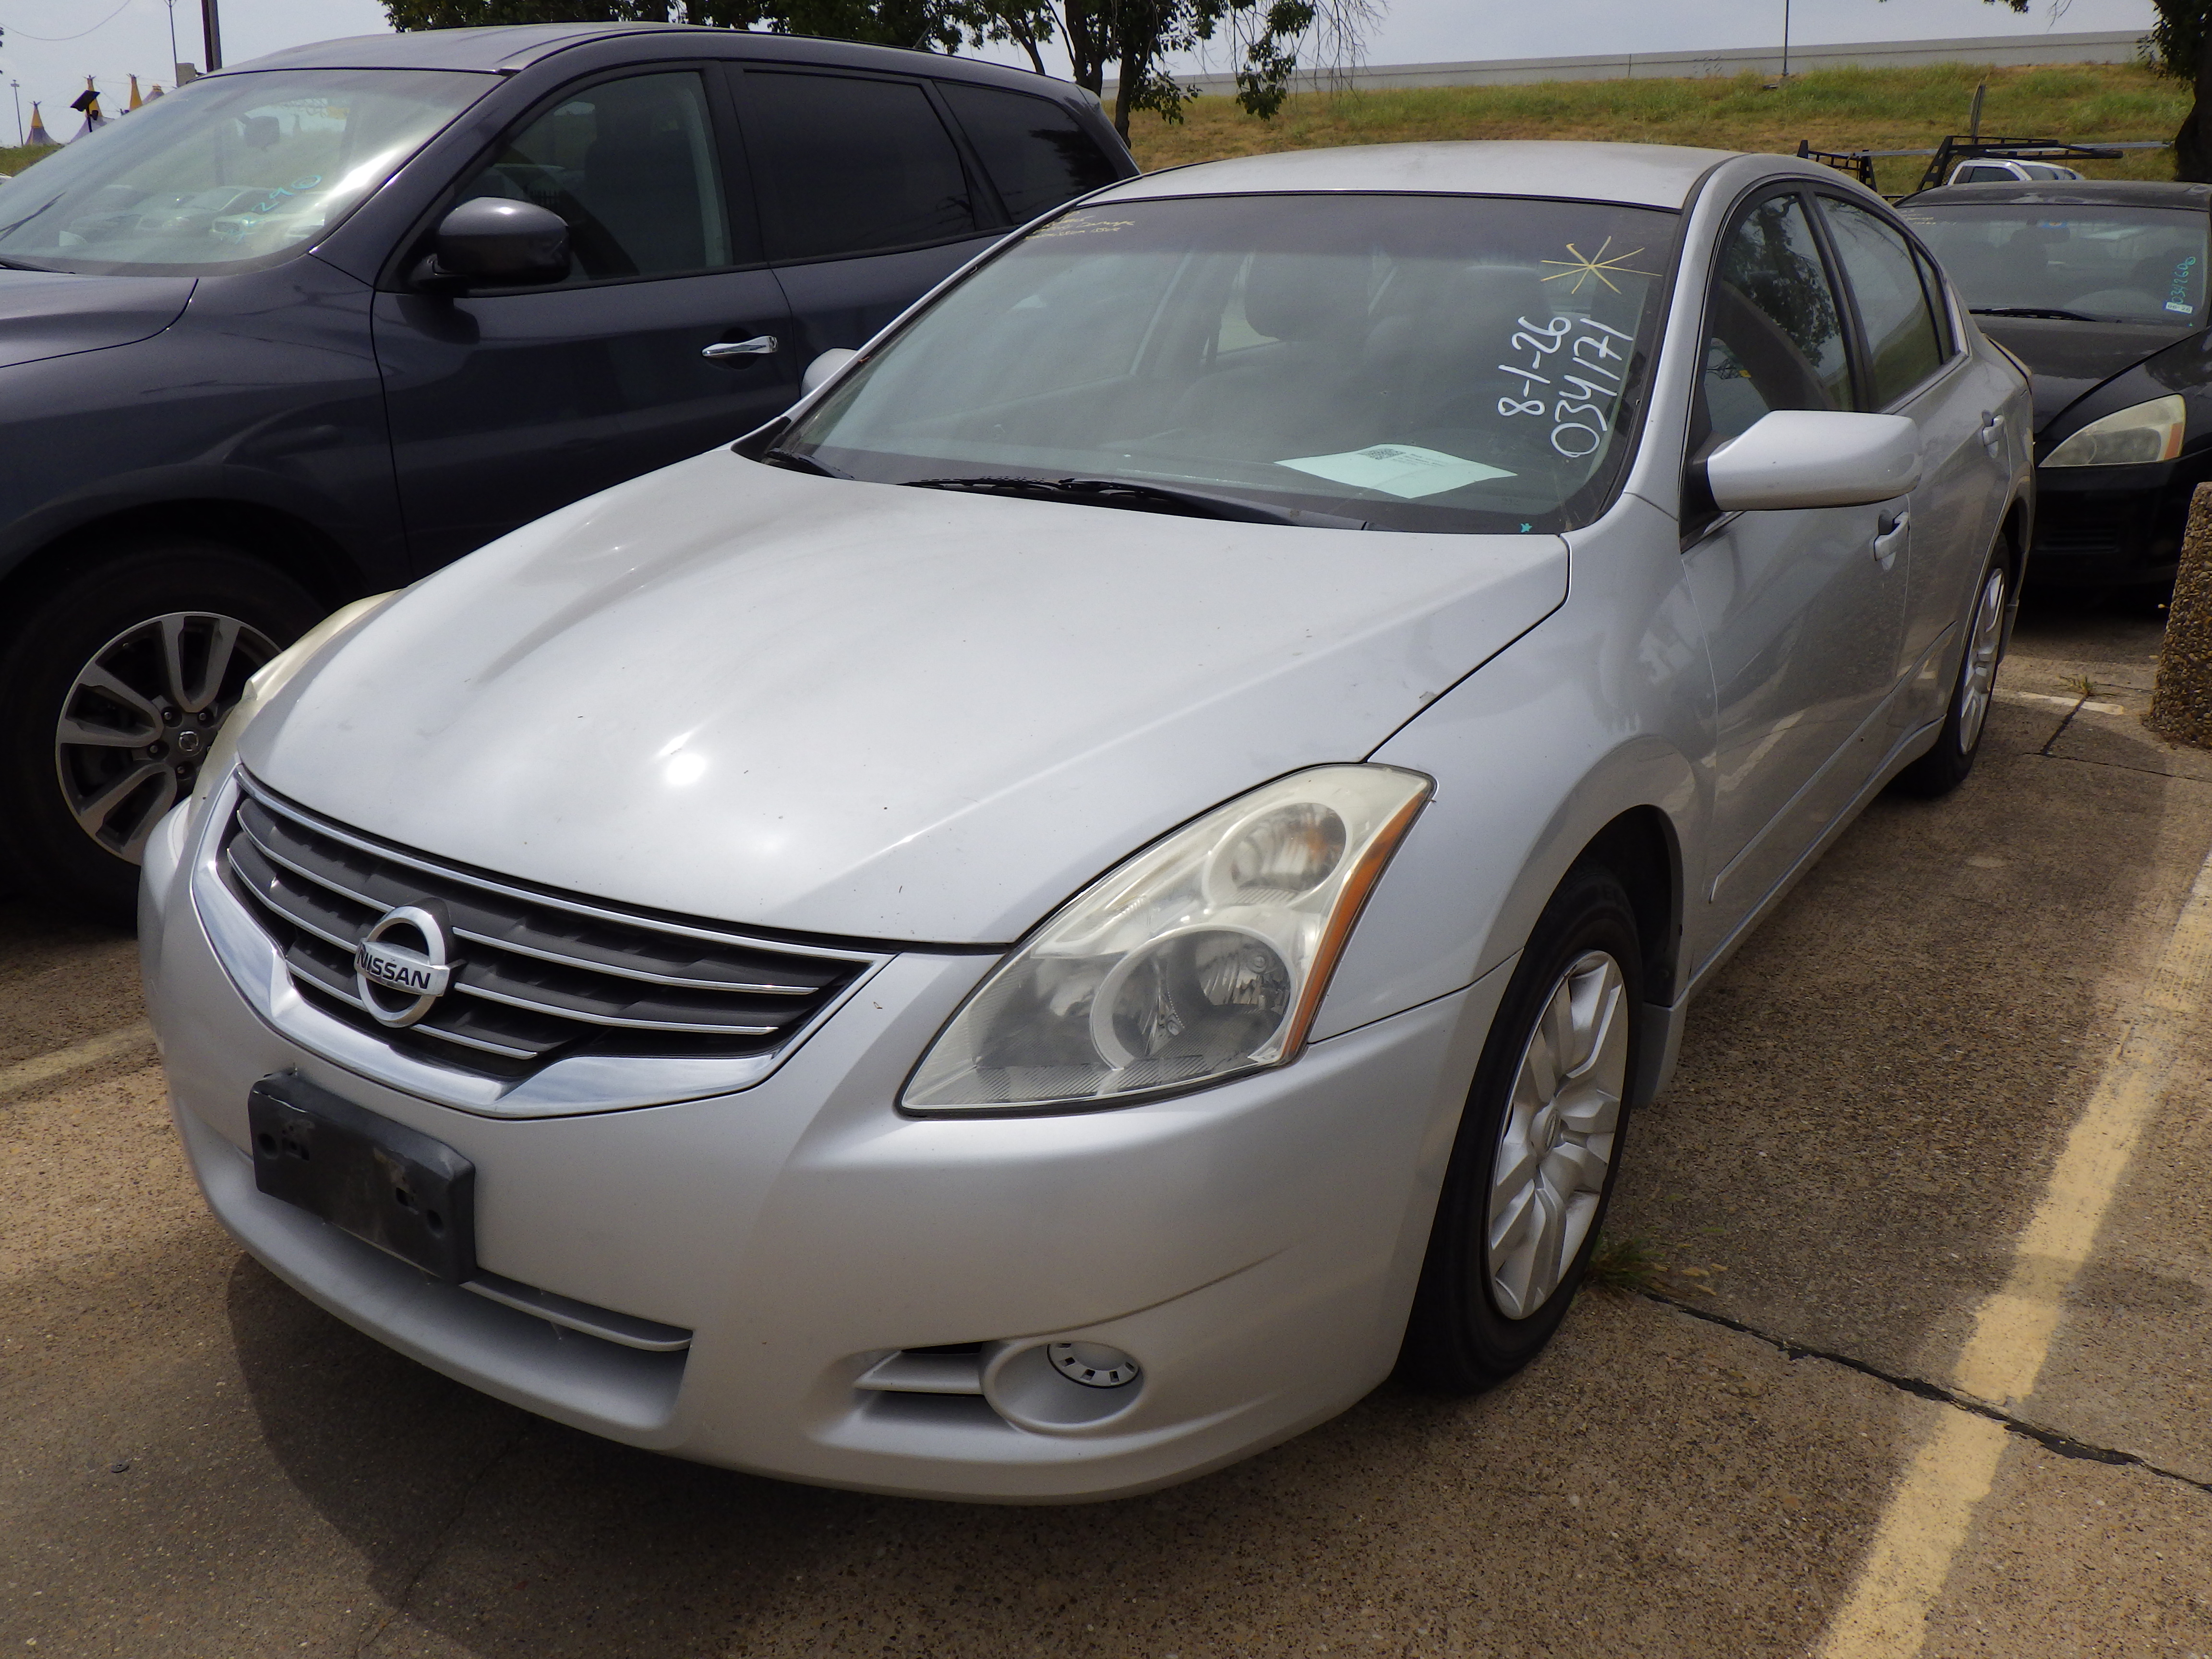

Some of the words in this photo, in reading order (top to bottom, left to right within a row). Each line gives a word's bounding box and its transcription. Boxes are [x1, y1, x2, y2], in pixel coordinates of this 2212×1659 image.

[1498, 316, 1572, 416] 8-1-26
[1551, 317, 1634, 458] 034171
[356, 946, 431, 990] NISSAN
